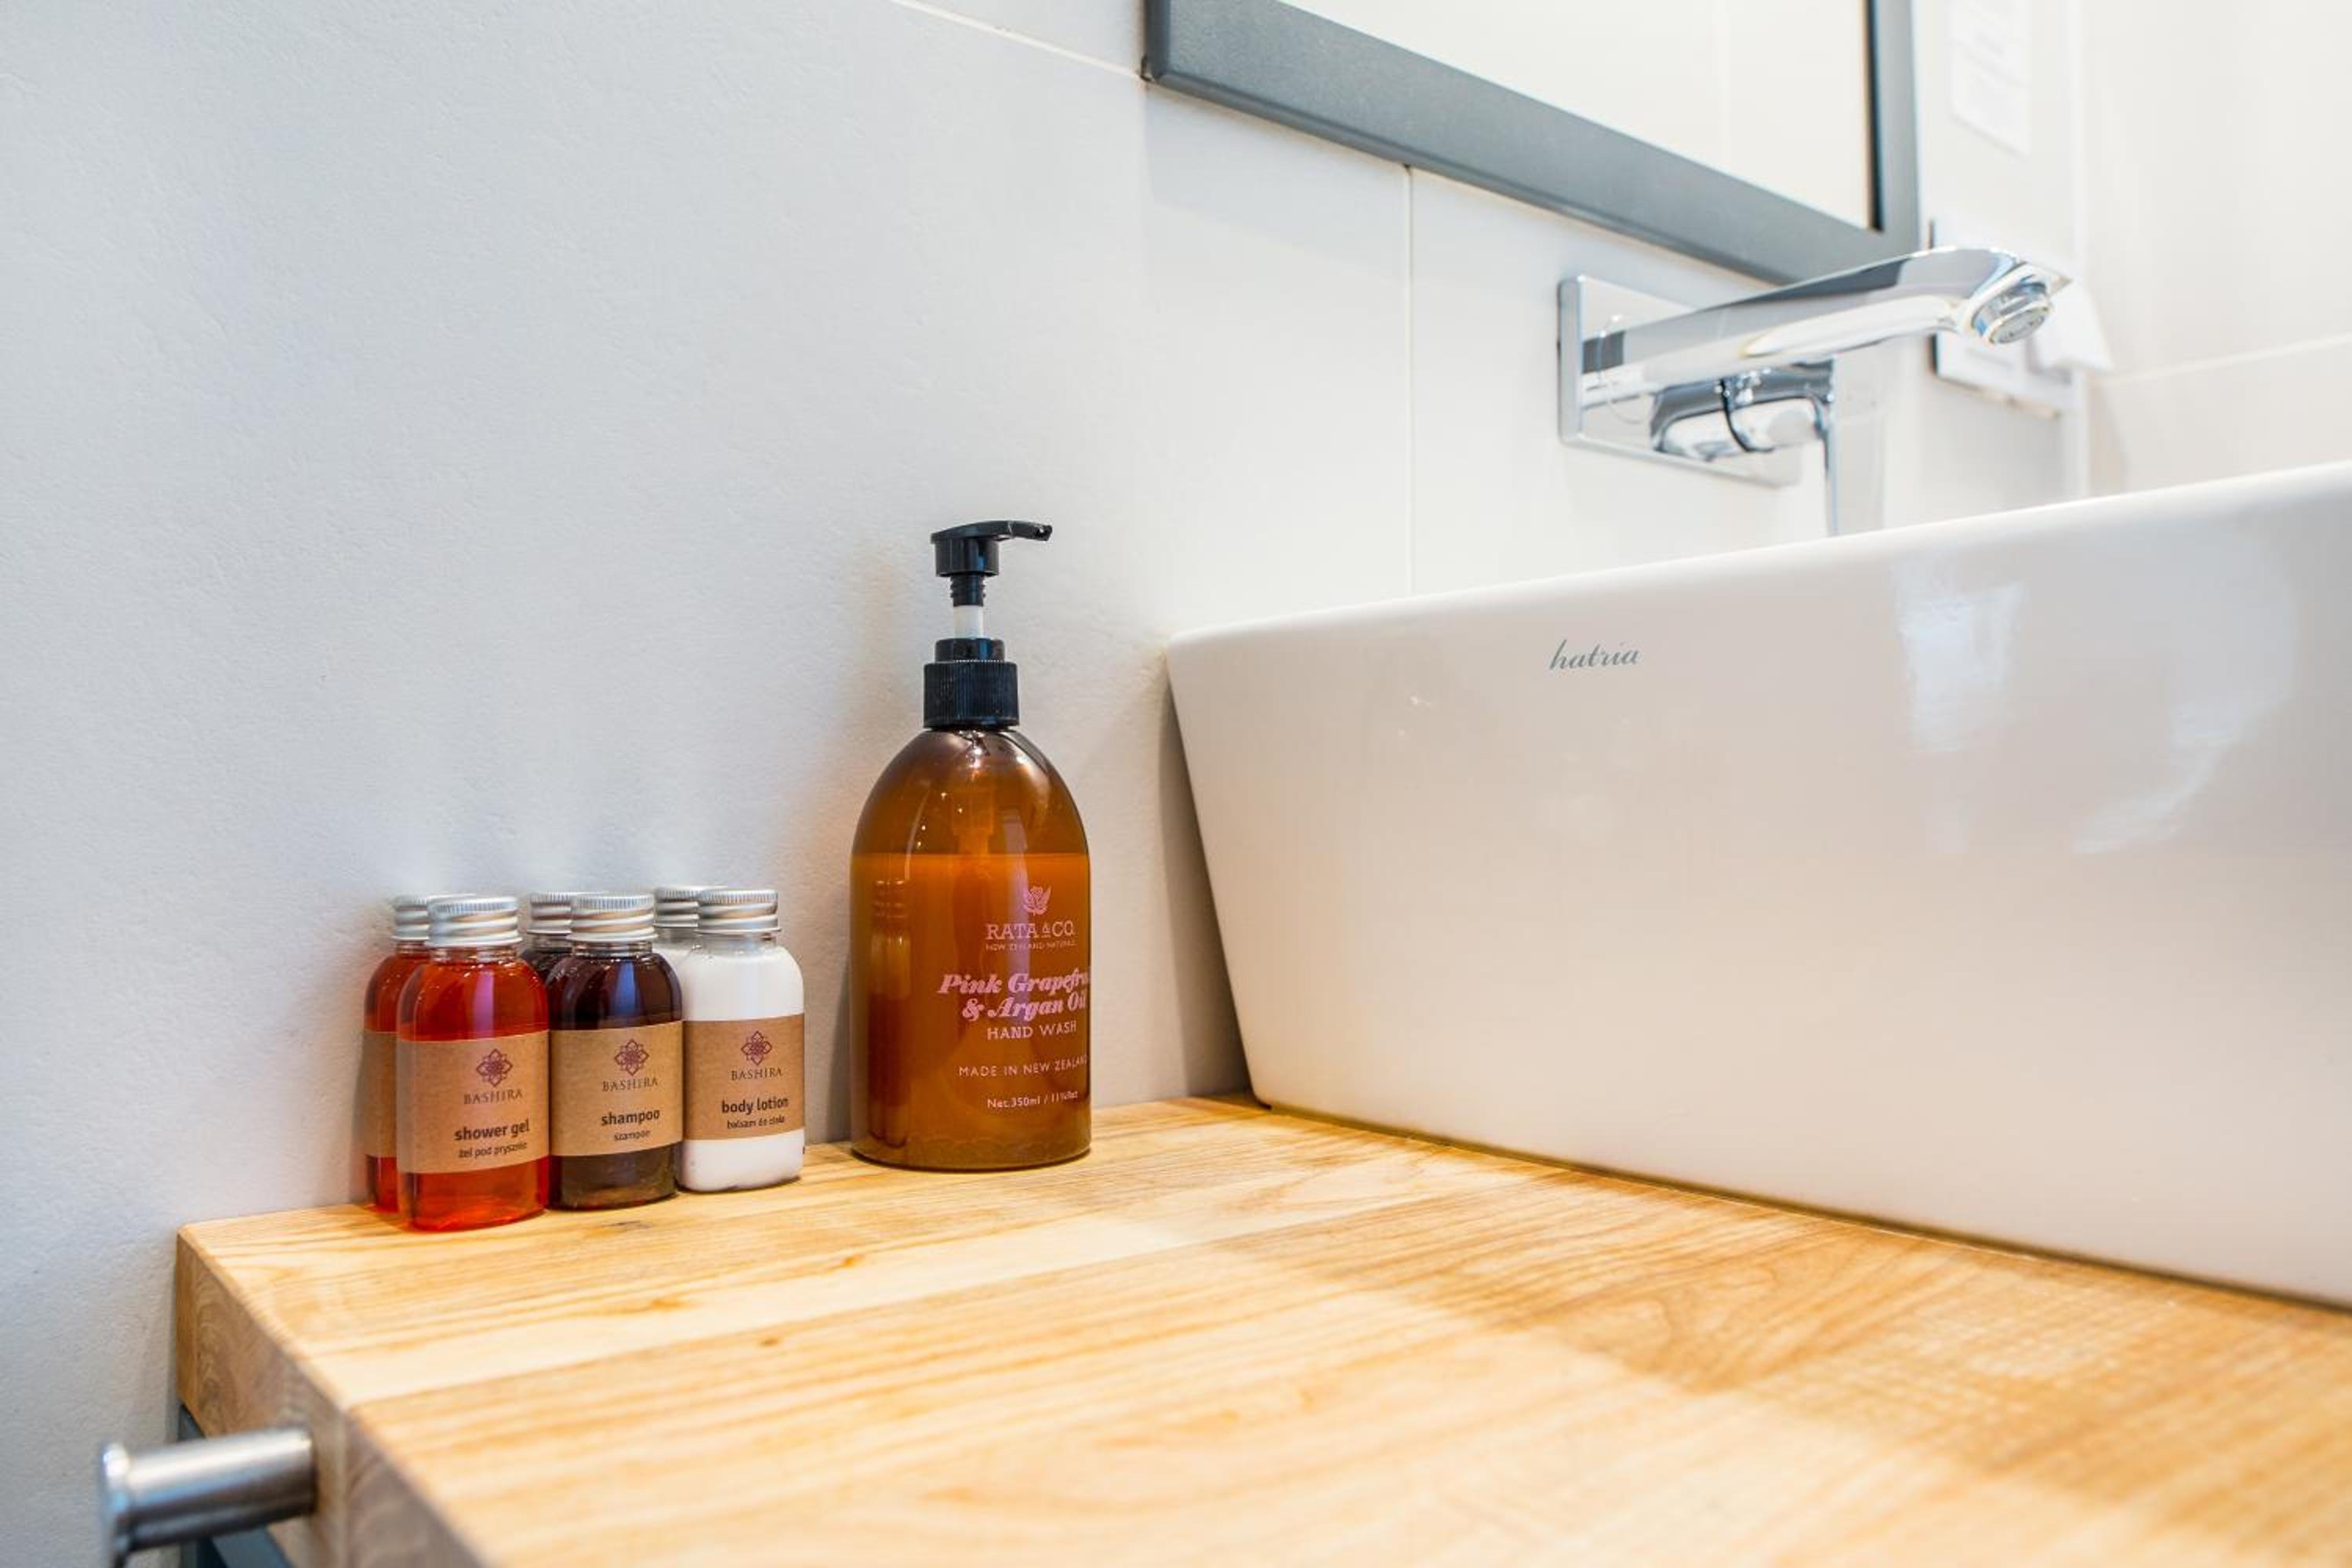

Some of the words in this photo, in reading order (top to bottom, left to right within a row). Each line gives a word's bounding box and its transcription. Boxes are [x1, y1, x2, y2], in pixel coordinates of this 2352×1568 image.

[1549, 639, 1639, 670] hatria
[985, 923, 1040, 939] RATA
[937, 973, 1004, 994] Pink
[962, 998, 985, 1022] &
[987, 996, 1064, 1022] Argan
[987, 1025, 1034, 1040] HAND
[1040, 1021, 1077, 1036] WASH
[731, 1067, 783, 1080] BASHIRA
[959, 1065, 997, 1077] MADE
[1004, 1065, 1018, 1076] IN
[1023, 1062, 1050, 1075] NEW
[602, 1077, 658, 1091] BASHIRA
[463, 1089, 523, 1105] BASHIRA
[722, 1099, 753, 1116] body
[757, 1096, 788, 1111] lotion
[601, 1109, 660, 1126] shampoo
[454, 1125, 508, 1141] shower
[511, 1118, 530, 1138] gel
